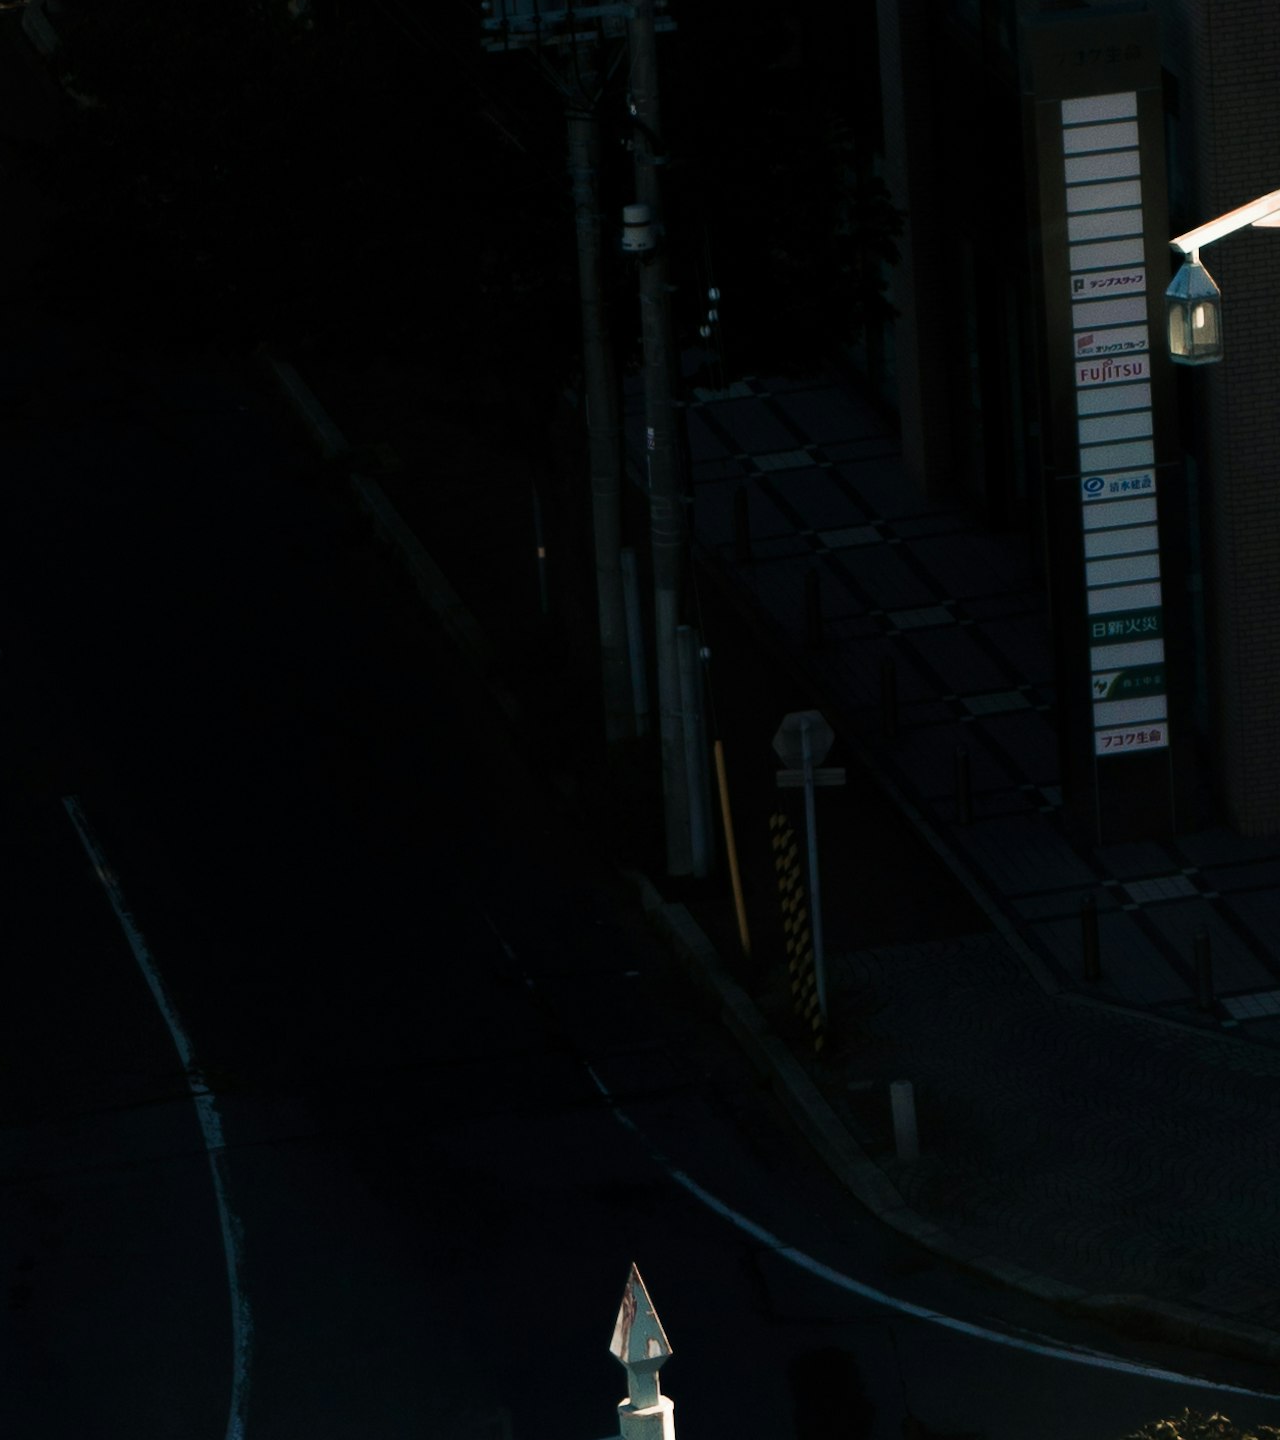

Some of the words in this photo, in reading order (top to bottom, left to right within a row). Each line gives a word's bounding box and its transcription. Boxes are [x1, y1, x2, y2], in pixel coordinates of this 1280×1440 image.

[1081, 360, 1142, 381] FUJITSU
[1092, 616, 1158, 638] 日新火災
[1101, 729, 1161, 748] フコク生命
